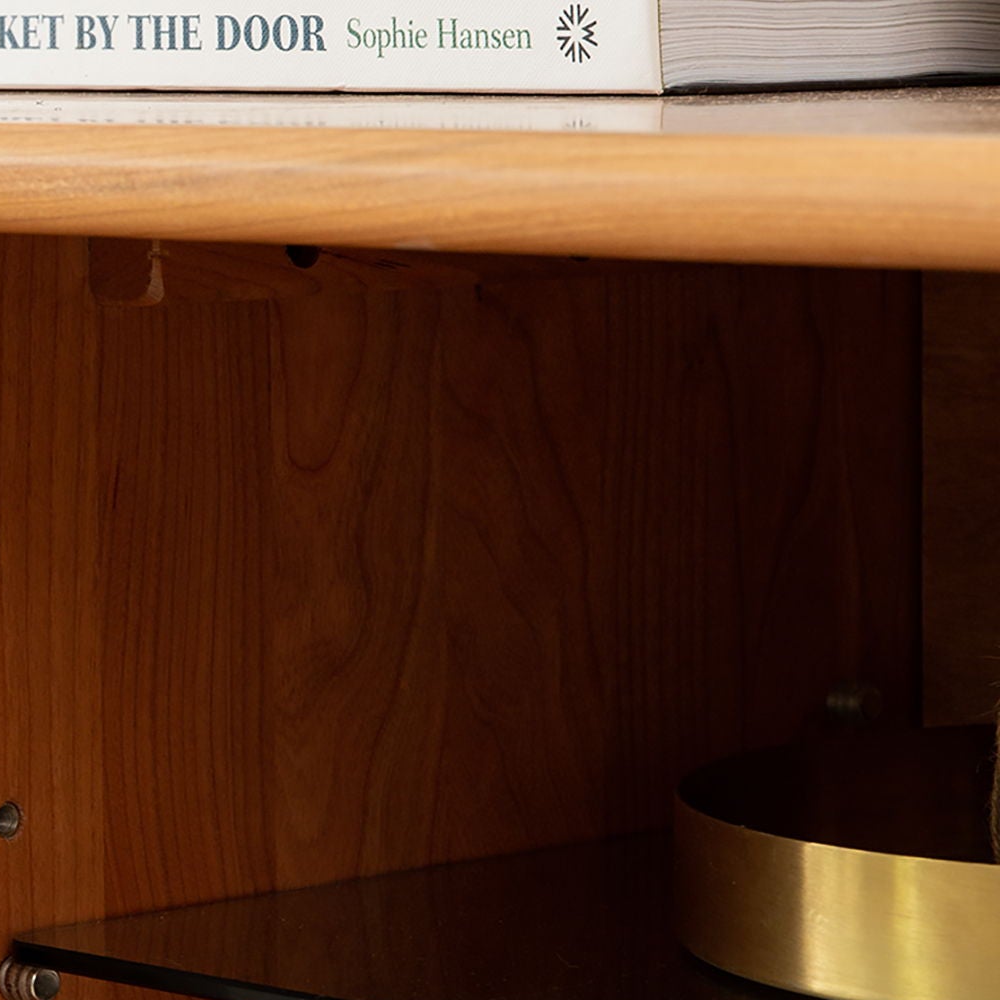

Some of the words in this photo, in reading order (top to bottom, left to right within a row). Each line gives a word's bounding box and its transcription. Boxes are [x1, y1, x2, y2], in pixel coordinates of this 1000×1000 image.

[74, 15, 119, 50] BY
[127, 15, 202, 51] THE
[215, 14, 327, 52] DOOR
[346, 17, 428, 58] Sophie
[436, 19, 533, 50] Hansen
